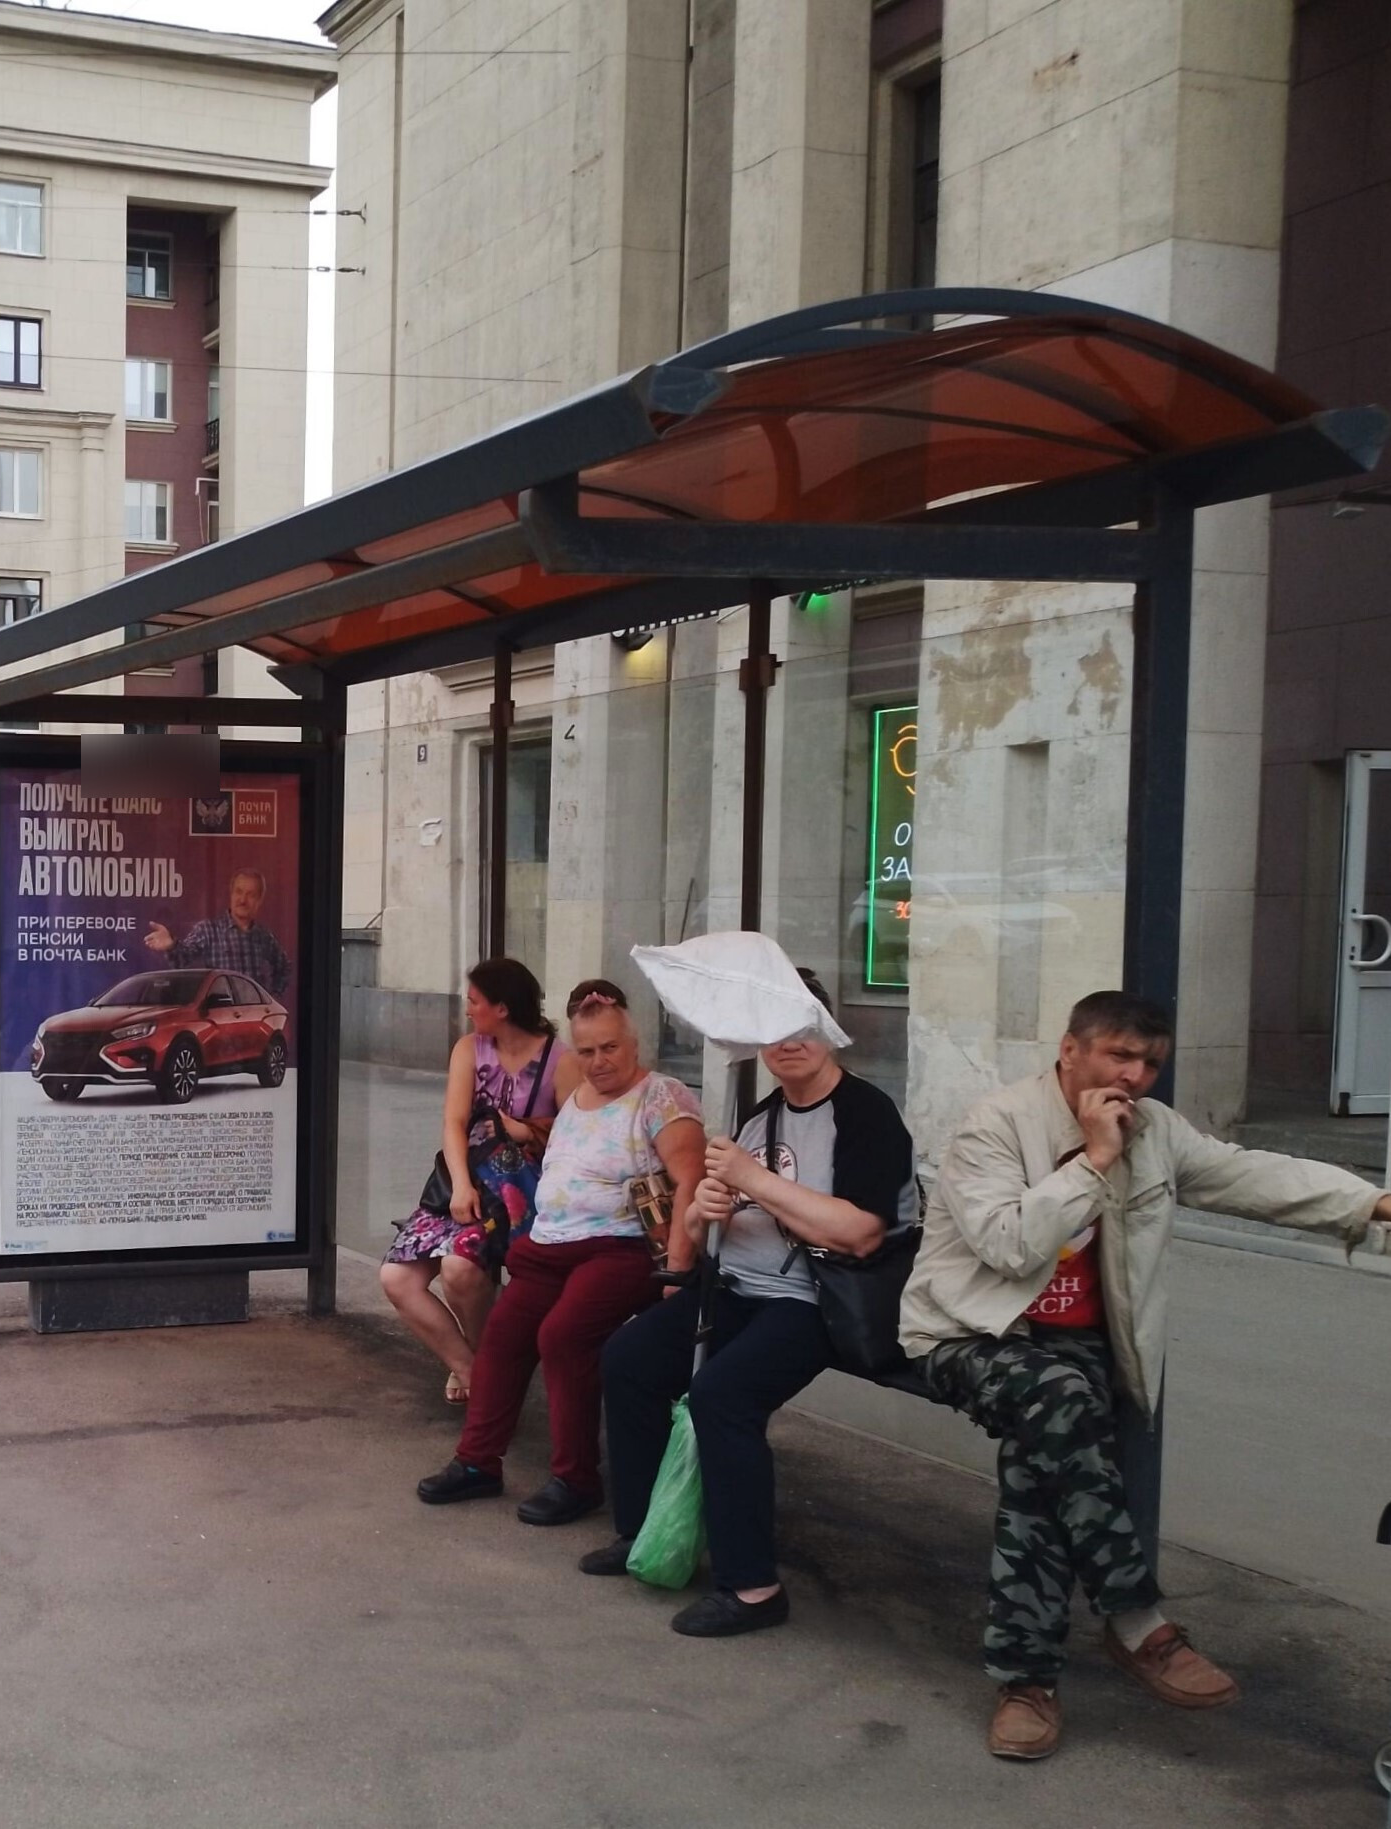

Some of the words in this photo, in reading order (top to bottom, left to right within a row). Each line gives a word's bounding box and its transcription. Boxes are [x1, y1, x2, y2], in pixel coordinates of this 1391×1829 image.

[239, 801, 271, 813] ПОЧТА
[239, 813, 267, 825] БАНК
[19, 818, 124, 853] ВЫИГРАТЬ
[18, 856, 184, 898] АВТОМОБИЛЬ
[18, 916, 50, 930] ПРИ
[55, 916, 137, 931] ПЕРЕВОДЕ
[18, 932, 84, 946] ПЕНСИИ
[18, 948, 29, 962] В
[32, 948, 83, 962] ПОЧТА
[87, 948, 127, 962] БАНК
[1042, 1276, 1081, 1293] АН
